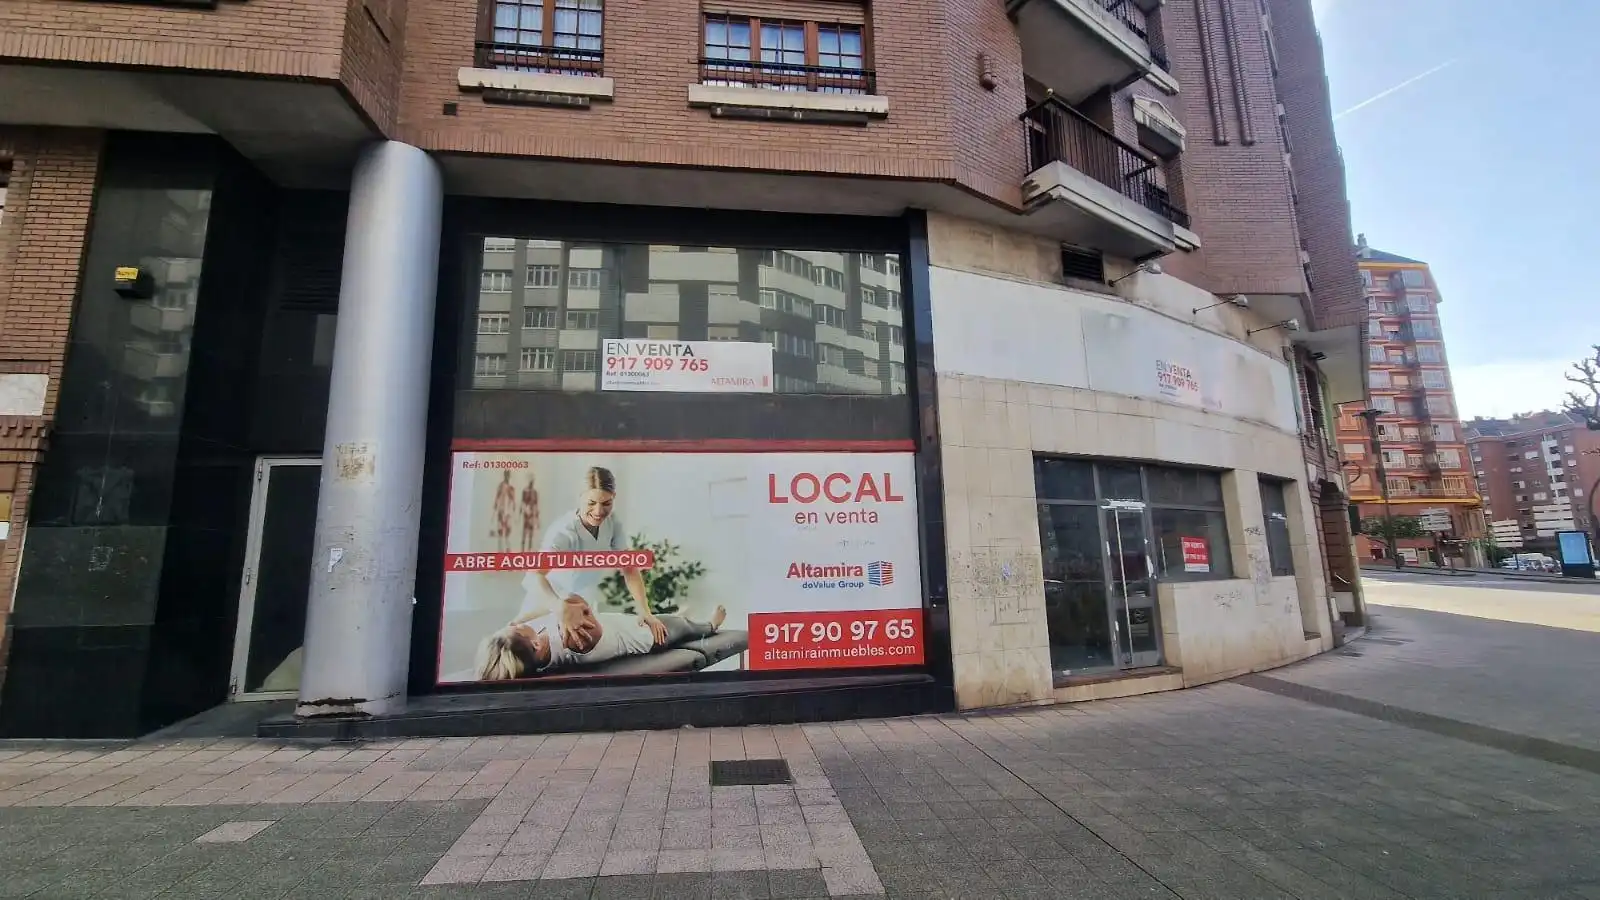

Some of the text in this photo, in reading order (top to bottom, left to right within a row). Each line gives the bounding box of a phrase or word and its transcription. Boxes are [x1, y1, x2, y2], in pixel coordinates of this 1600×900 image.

[607, 342, 694, 357] EN VENTA
[606, 357, 709, 372] 917 909 765
[711, 376, 755, 387] ALTAMIRA
[1157, 371, 1171, 384] 917
[462, 460, 529, 469] Ref: 01300063
[768, 472, 904, 504] LOCAL
[794, 508, 879, 524] en venta
[453, 553, 648, 569] ABRE AQUÍ TU NEGOCIO
[786, 562, 864, 579] Altamira
[802, 580, 865, 589] doValue Group
[764, 619, 915, 644] 917 90 97 65
[764, 643, 916, 661] altamirainmuebles.com
